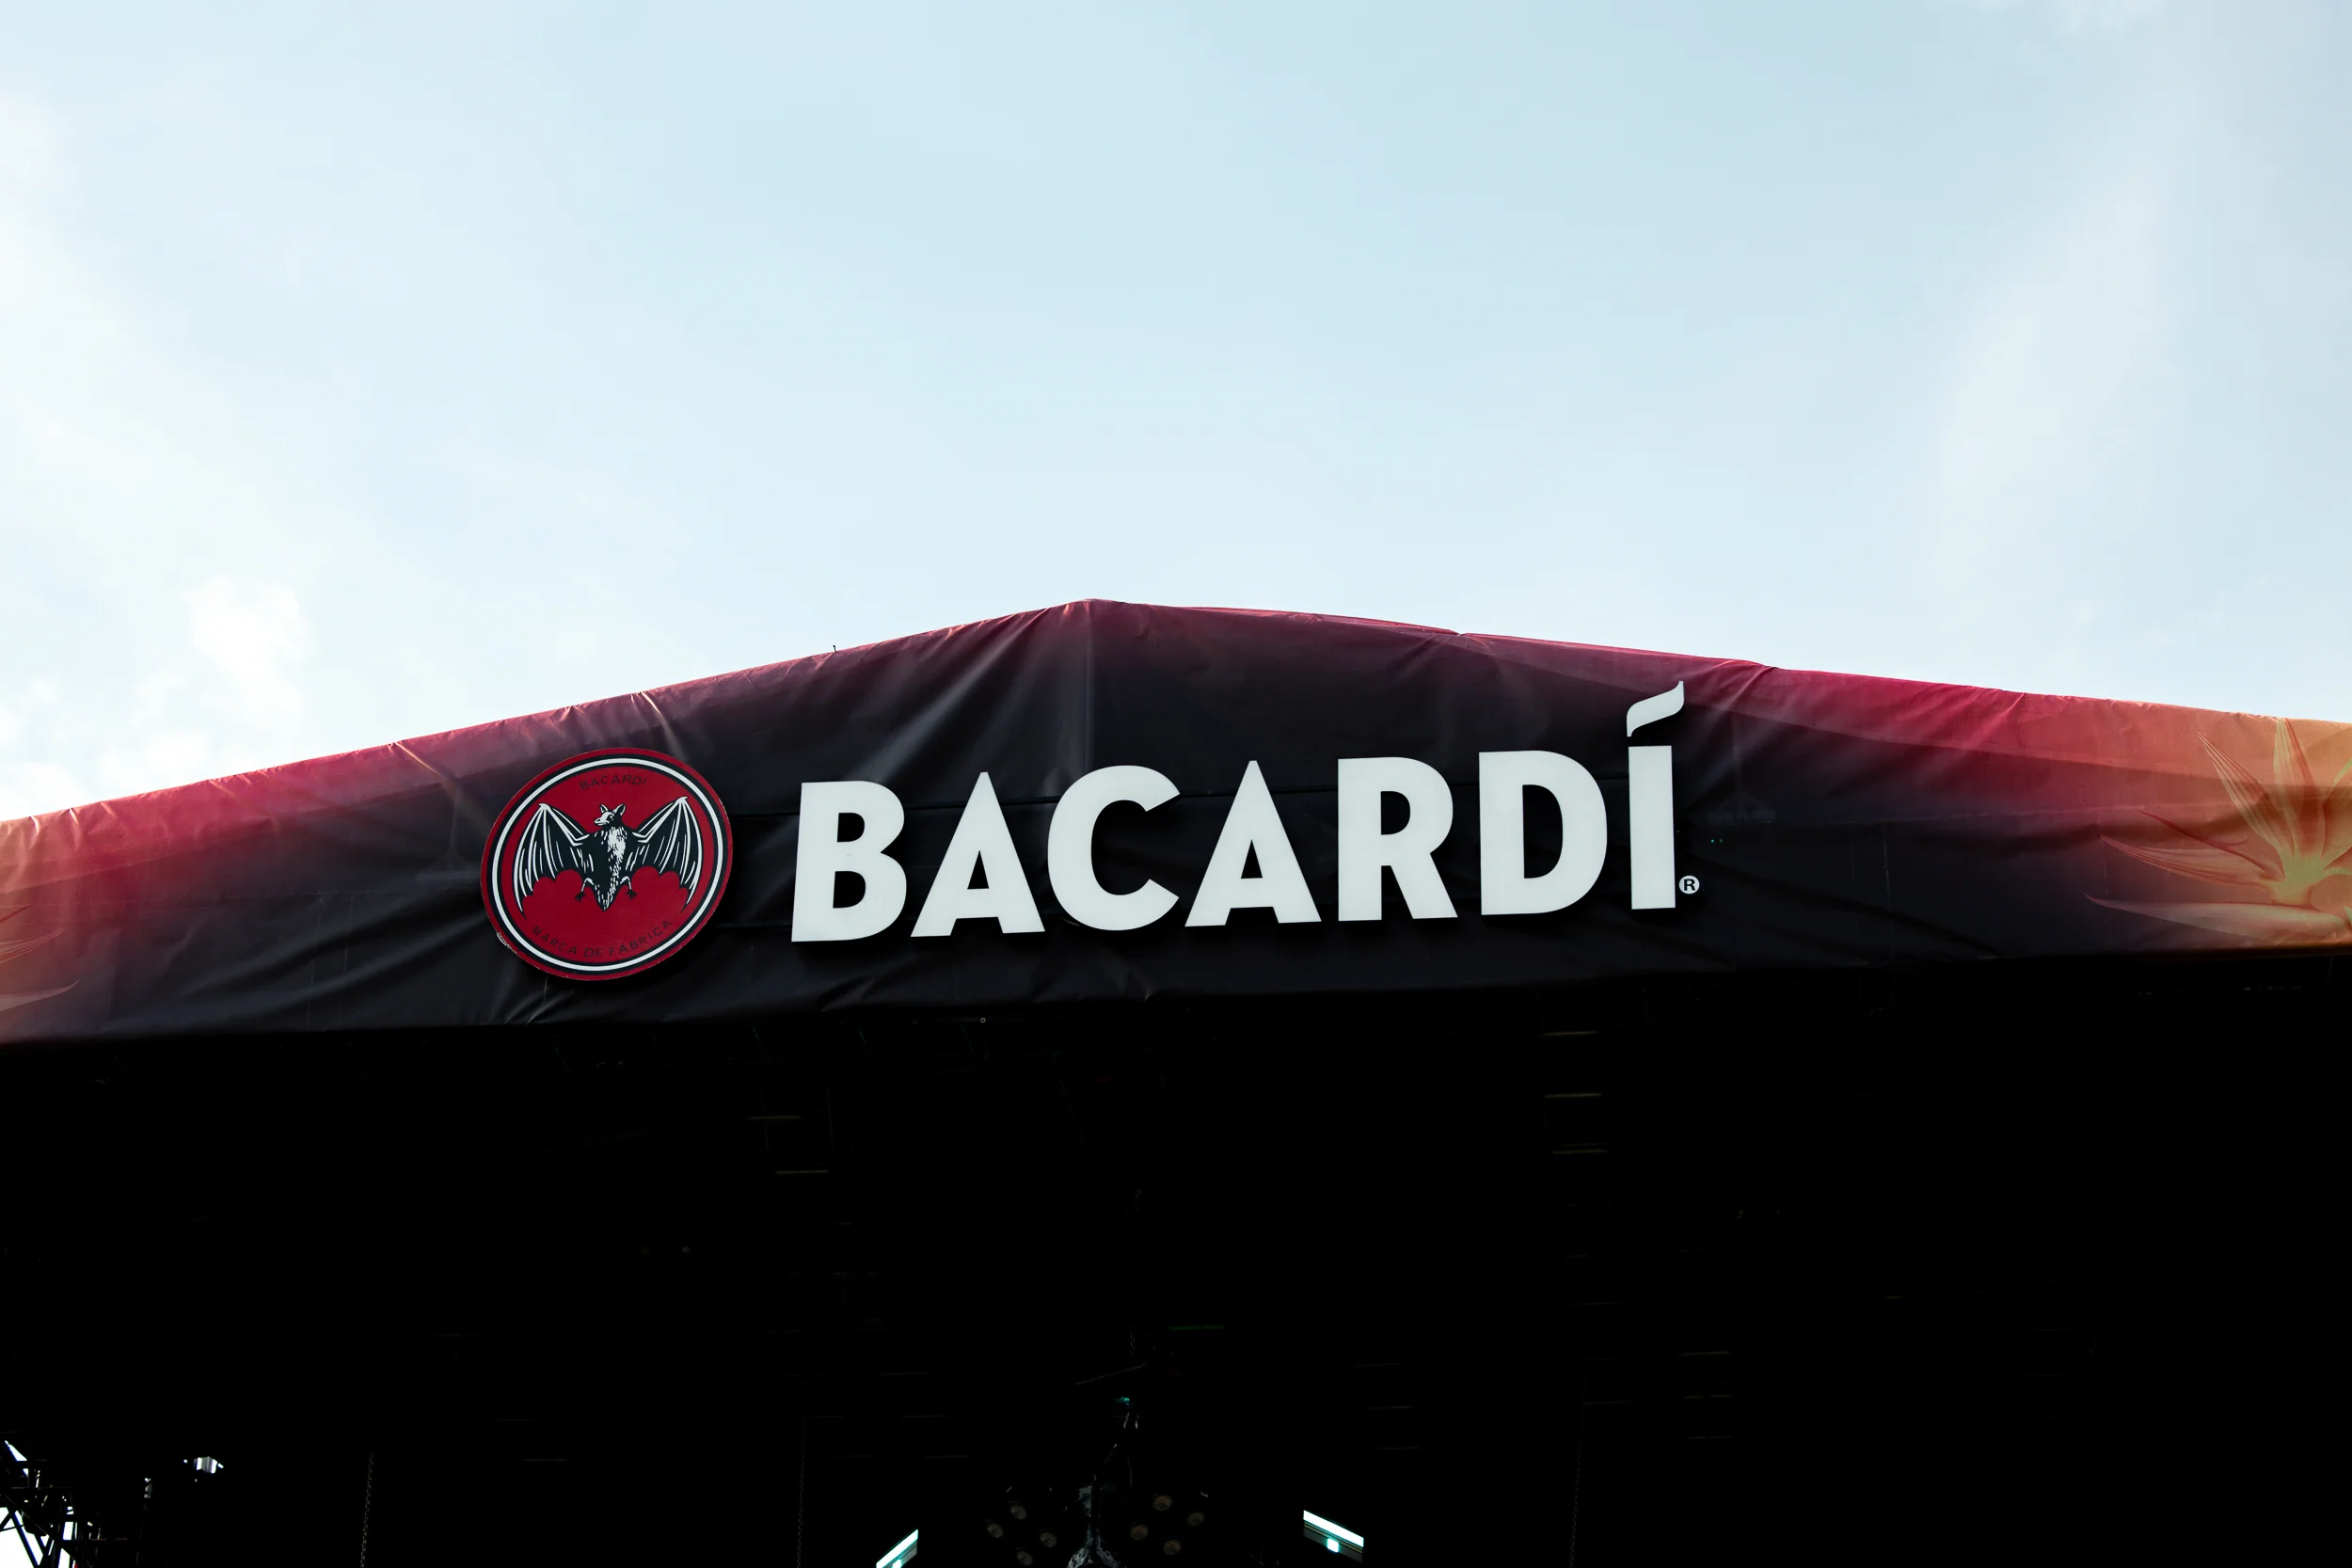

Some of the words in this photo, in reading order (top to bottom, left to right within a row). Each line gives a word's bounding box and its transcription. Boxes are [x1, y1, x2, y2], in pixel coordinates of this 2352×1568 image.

[791, 681, 1684, 942] BACARDÍ
[532, 926, 577, 955] MARCA
[583, 947, 602, 958] DE
